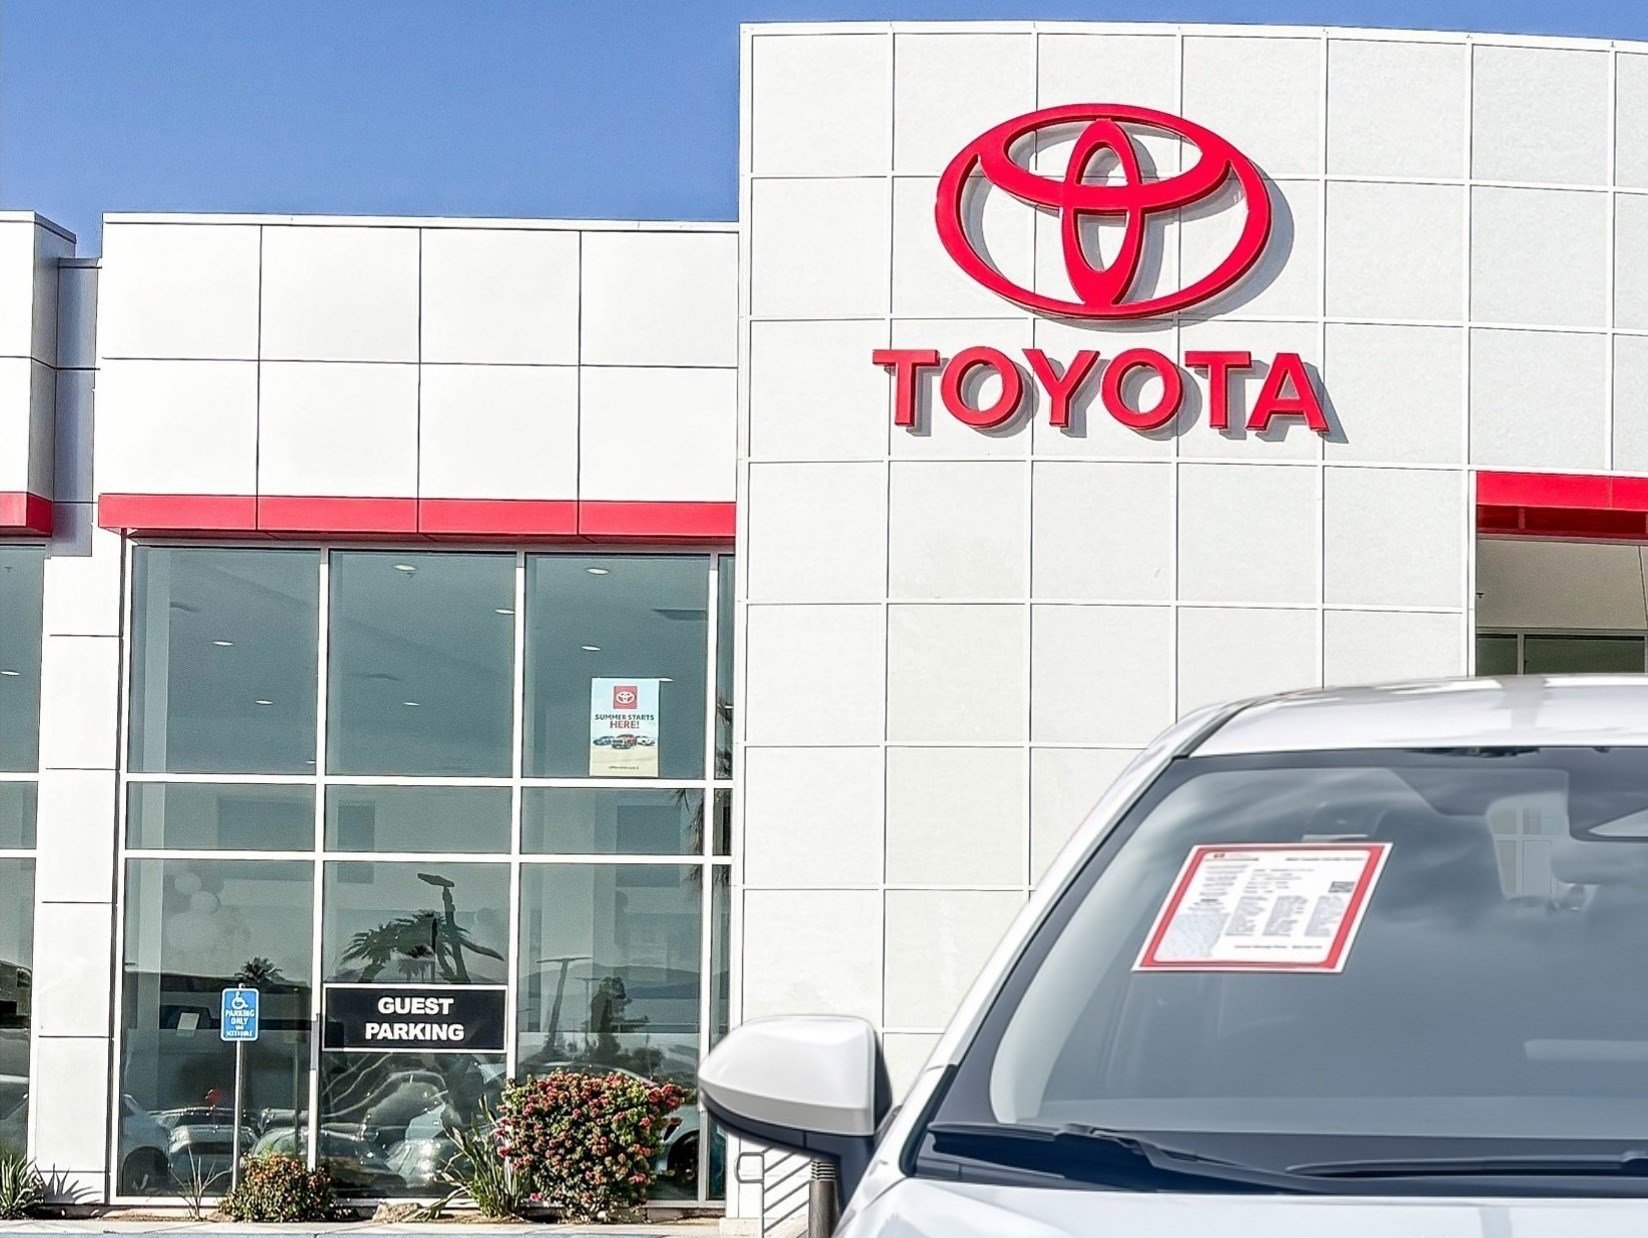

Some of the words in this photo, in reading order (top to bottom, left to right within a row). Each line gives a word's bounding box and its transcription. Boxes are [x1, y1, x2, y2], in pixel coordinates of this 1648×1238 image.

[873, 346, 1329, 433] TOYOTA
[610, 721, 639, 729] HERE!
[225, 1009, 255, 1017] PARKING
[378, 997, 455, 1014] GUEST
[365, 1023, 465, 1041] PARKING
